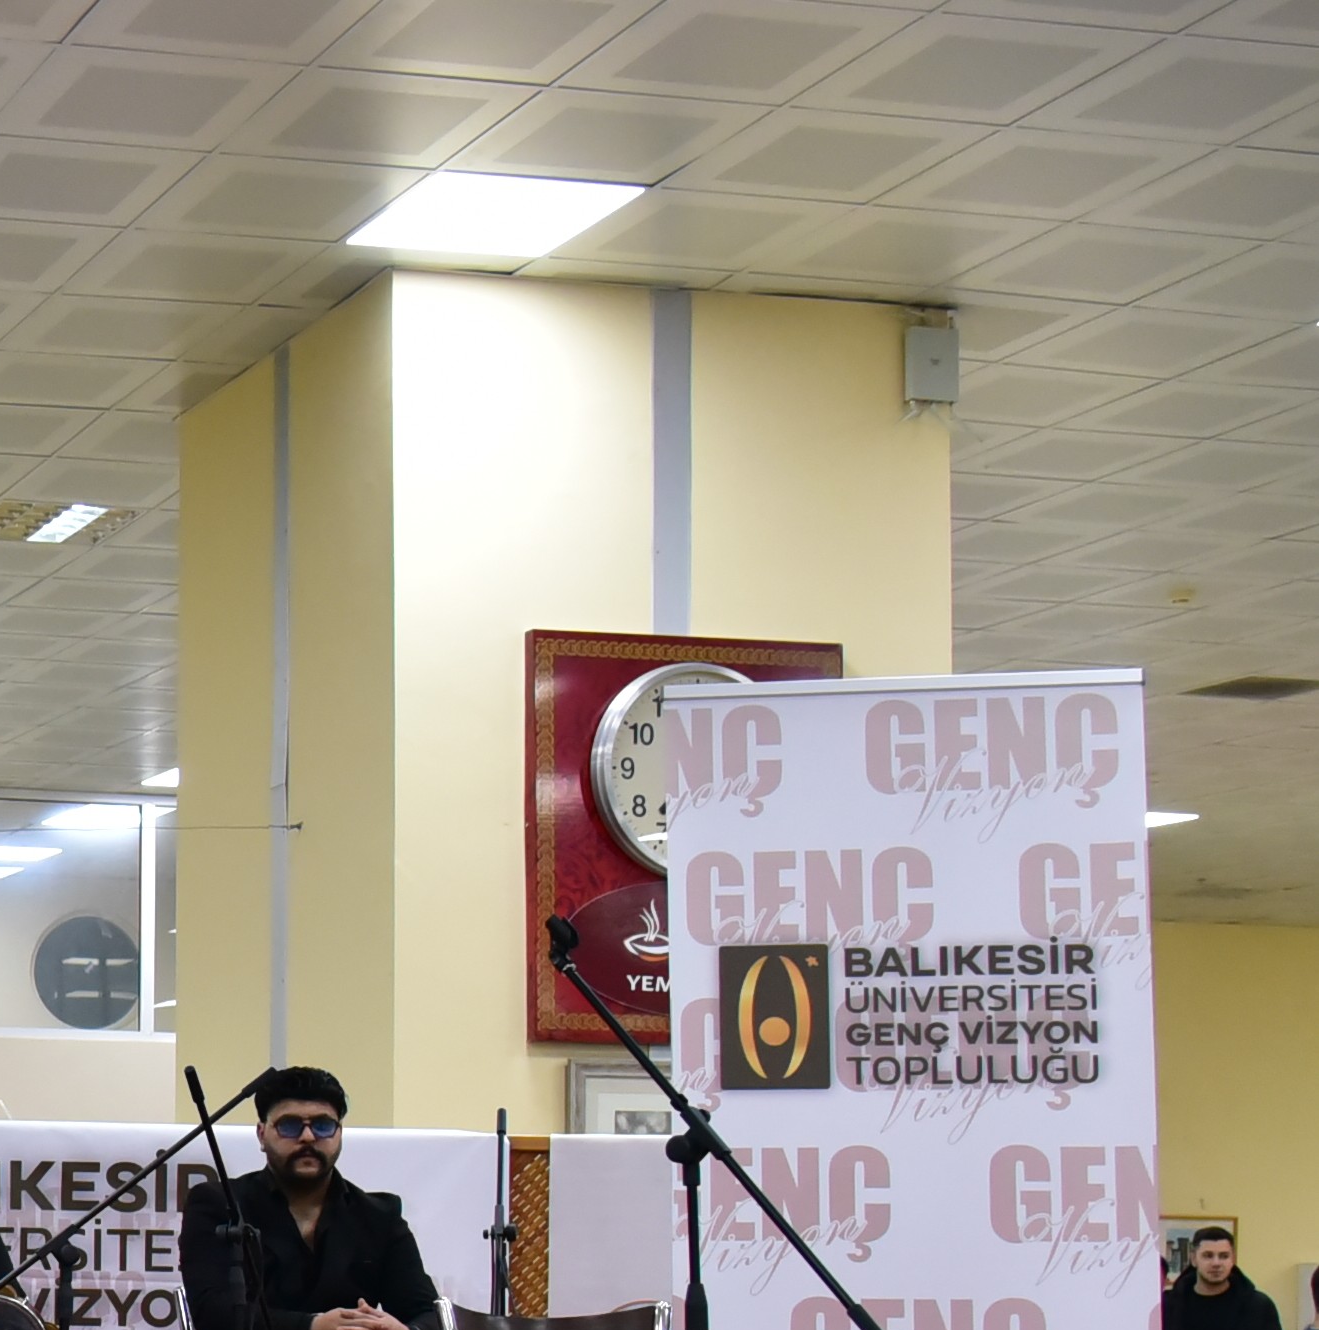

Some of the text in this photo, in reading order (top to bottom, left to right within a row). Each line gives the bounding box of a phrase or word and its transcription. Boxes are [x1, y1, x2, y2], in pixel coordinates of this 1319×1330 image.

[628, 722, 654, 746] 10
[864, 693, 1119, 808] GENÇ
[620, 757, 635, 779] 9
[631, 795, 647, 817] 8
[844, 936, 1096, 979] BALIKESİR
[844, 978, 1098, 1013] ÜNİVERSİTESİ
[845, 1014, 1099, 1054] GENÇ VİZYON
[845, 1048, 1099, 1086] TOPLULUĞU
